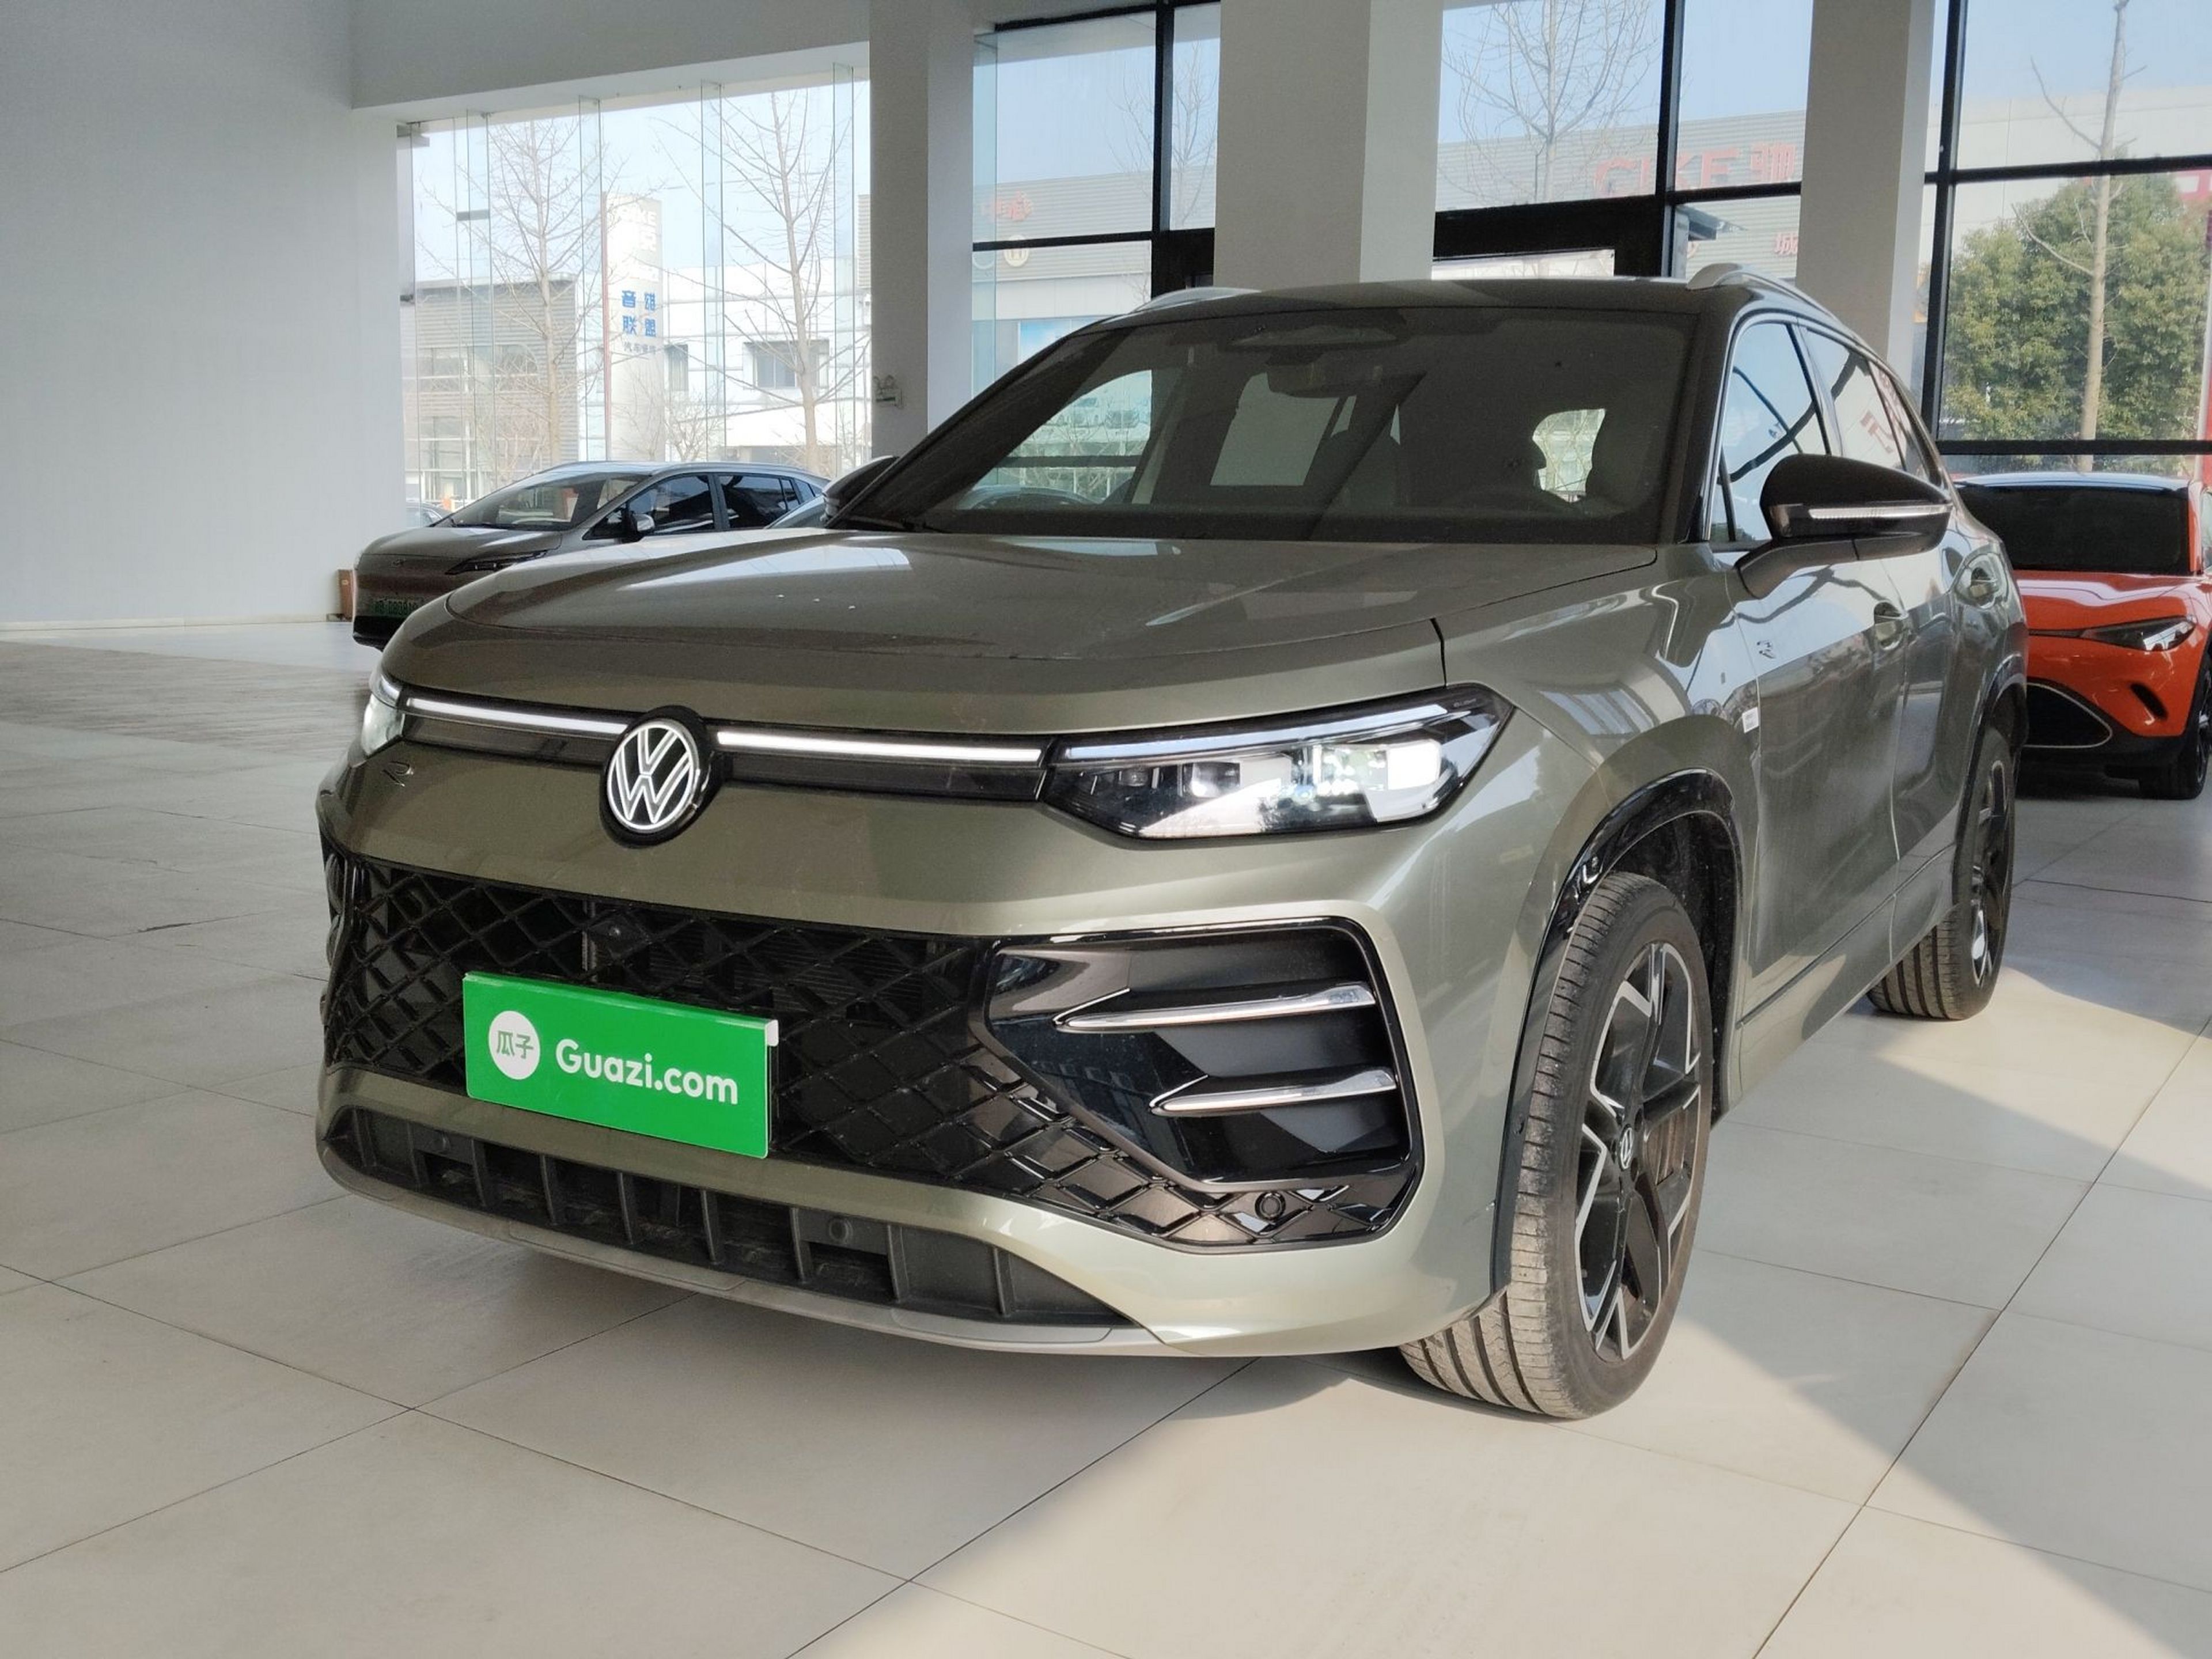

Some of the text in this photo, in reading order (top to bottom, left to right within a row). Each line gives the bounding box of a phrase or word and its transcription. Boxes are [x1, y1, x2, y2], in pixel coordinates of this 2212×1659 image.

[622, 316, 656, 337] 联盟
[496, 1029, 738, 1105] 瓜子 Guazi.com
